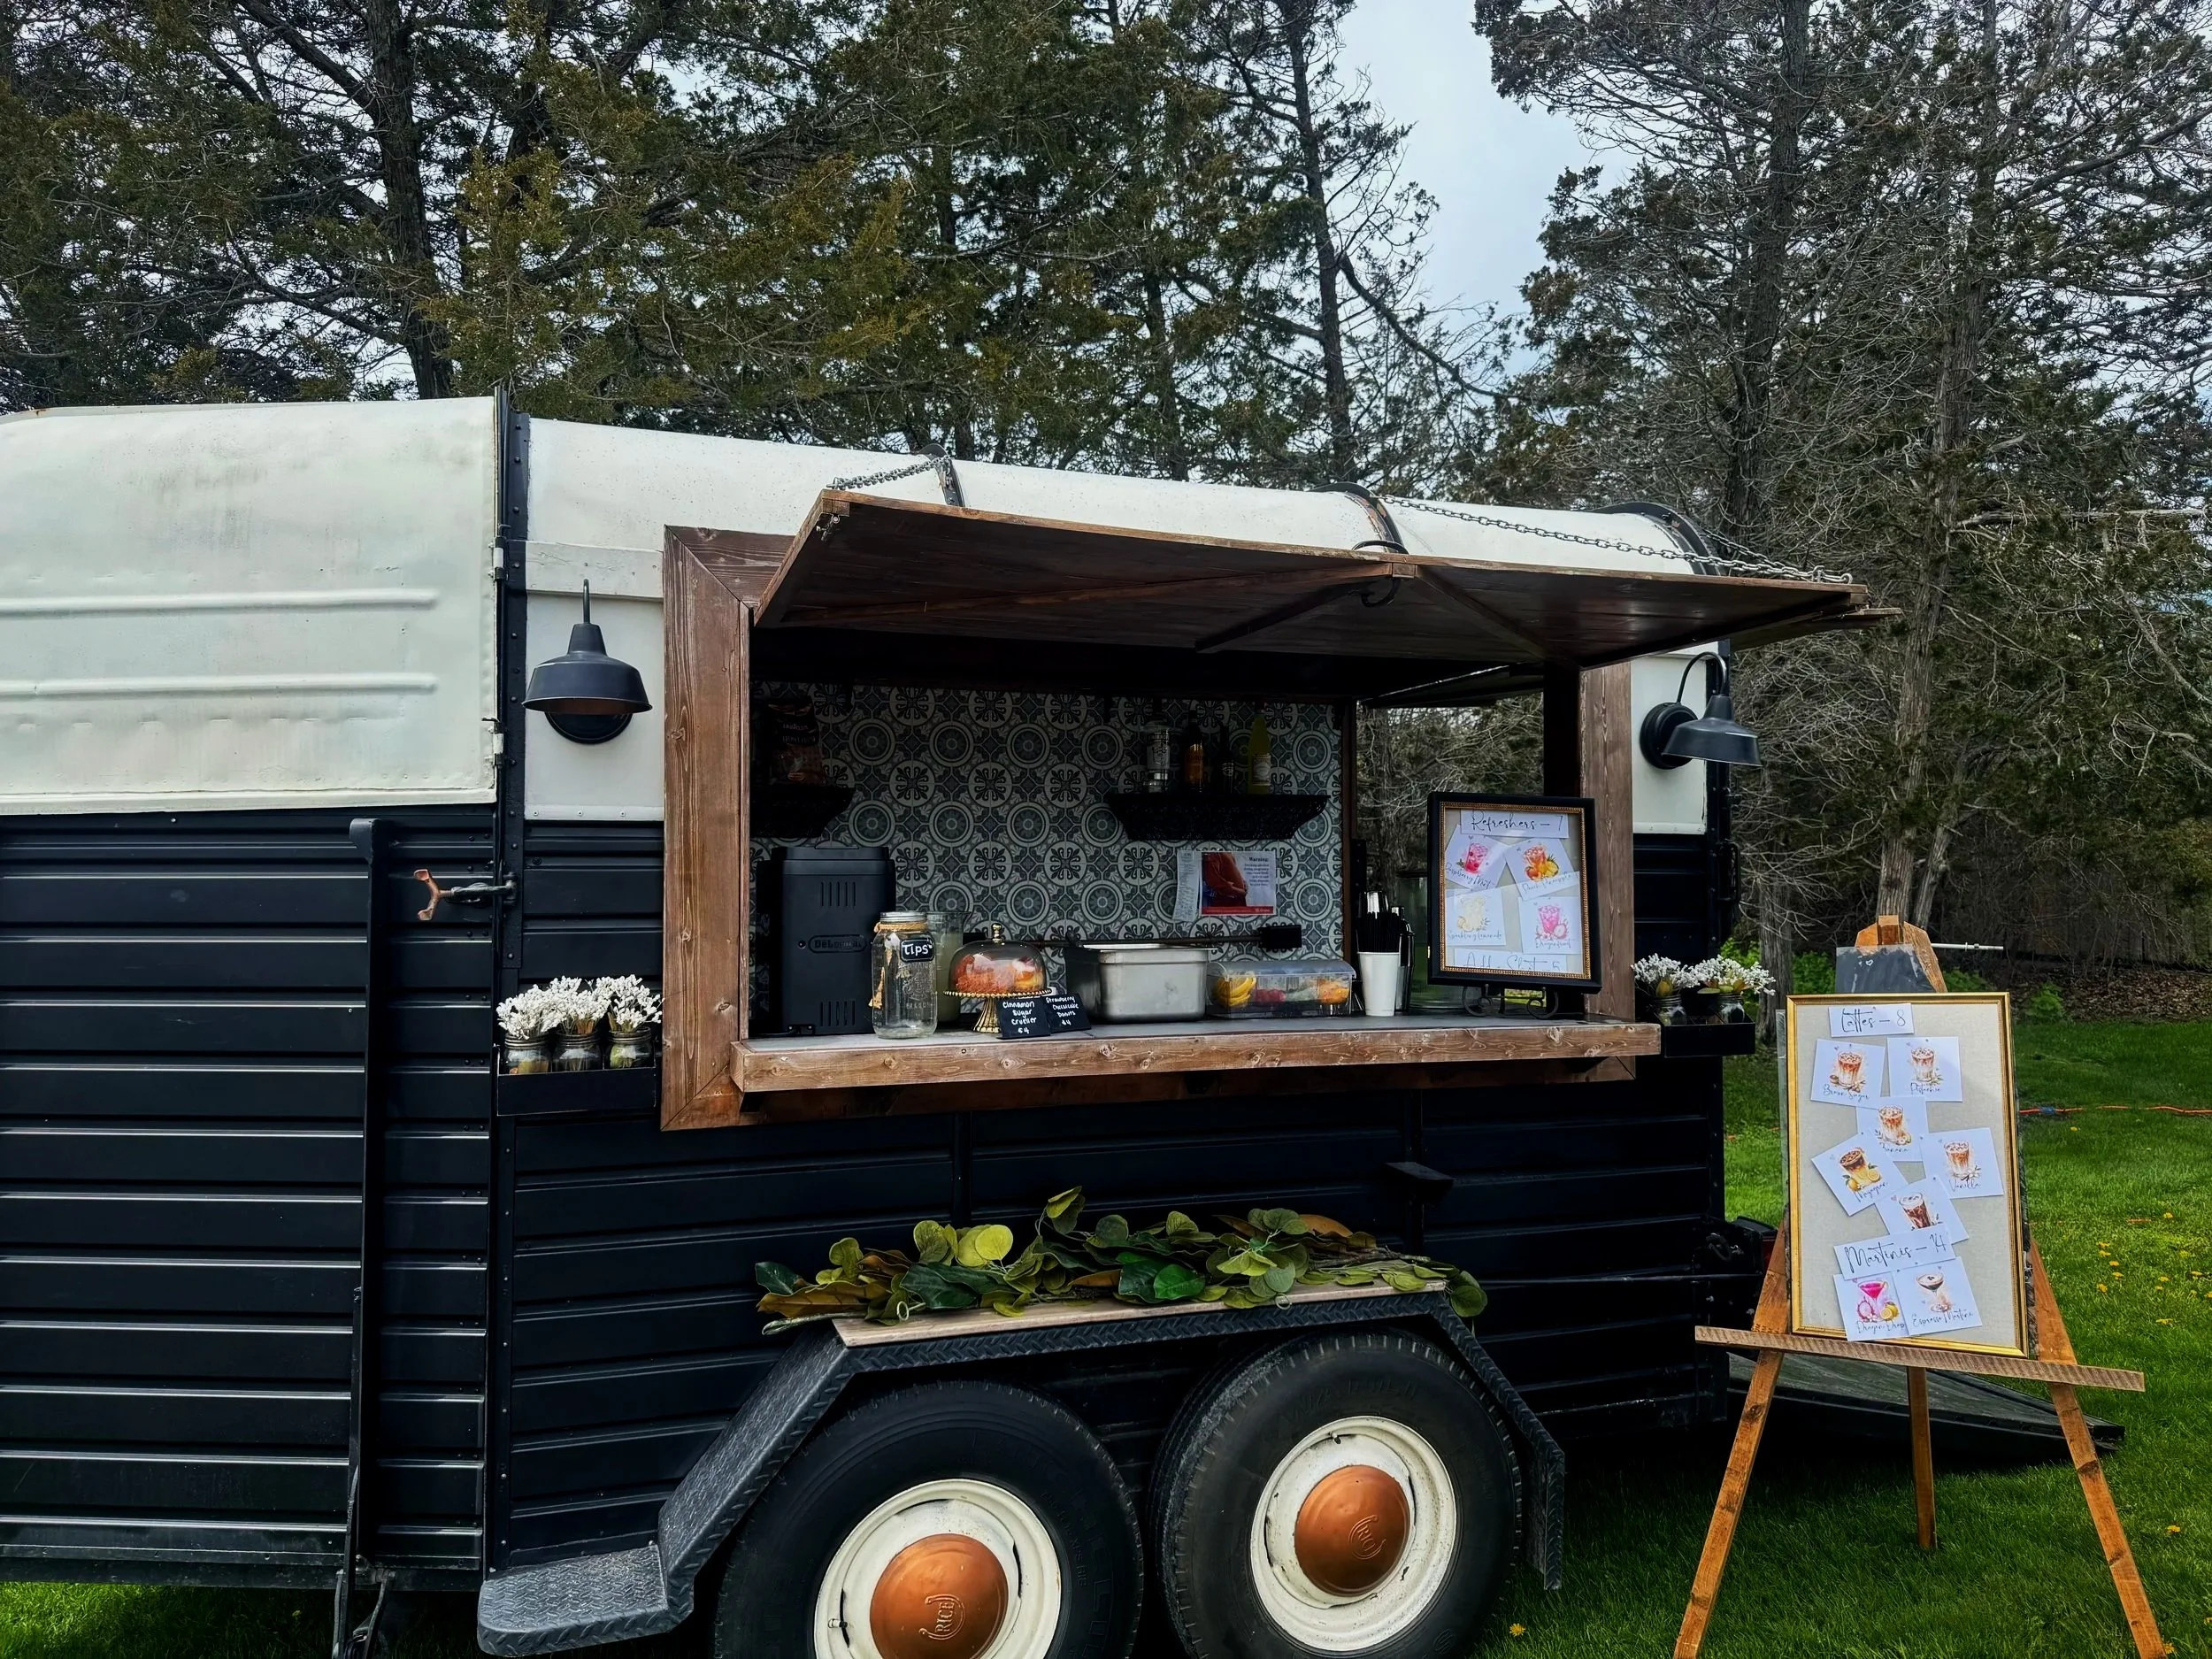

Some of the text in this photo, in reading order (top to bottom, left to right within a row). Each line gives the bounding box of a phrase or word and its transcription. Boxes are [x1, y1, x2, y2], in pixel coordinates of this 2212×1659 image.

[1471, 810, 1535, 831] Refreshers
[1012, 1009, 1033, 1018] Sugar
[1841, 1008, 1875, 1033] Lattes
[1896, 1009, 1906, 1026] 8
[1948, 1179, 1981, 1193] Vanilla
[1844, 1241, 1913, 1274] Martinis
[1855, 1319, 1885, 1335] Dragon
[1912, 1309, 1974, 1328] Espresso Martini
[934, 1601, 955, 1633] RICE
